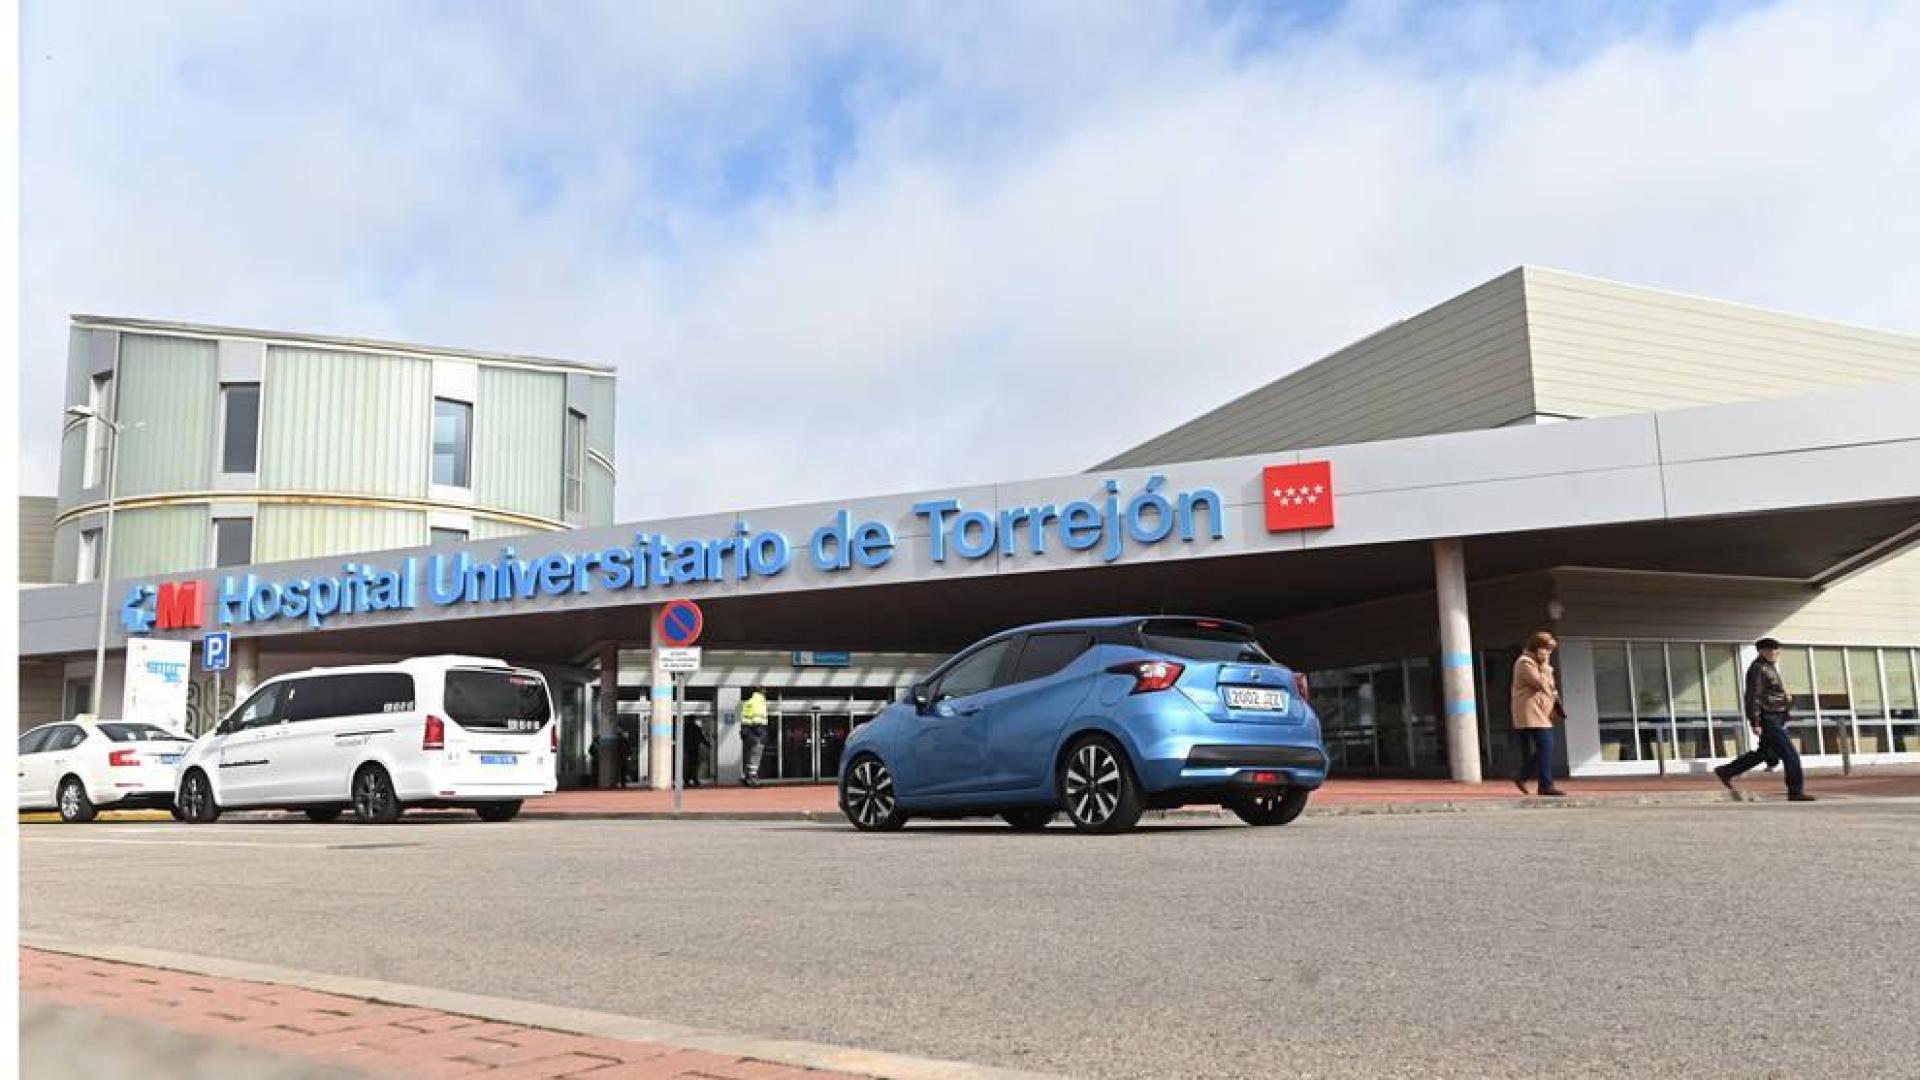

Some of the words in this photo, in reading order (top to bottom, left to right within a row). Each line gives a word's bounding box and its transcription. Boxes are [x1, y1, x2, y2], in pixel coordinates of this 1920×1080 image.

[218, 557, 416, 629] Hospital
[428, 521, 790, 606] Universitario
[809, 508, 895, 572] de
[912, 474, 1225, 563] Torrejón
[208, 637, 222, 666] P
